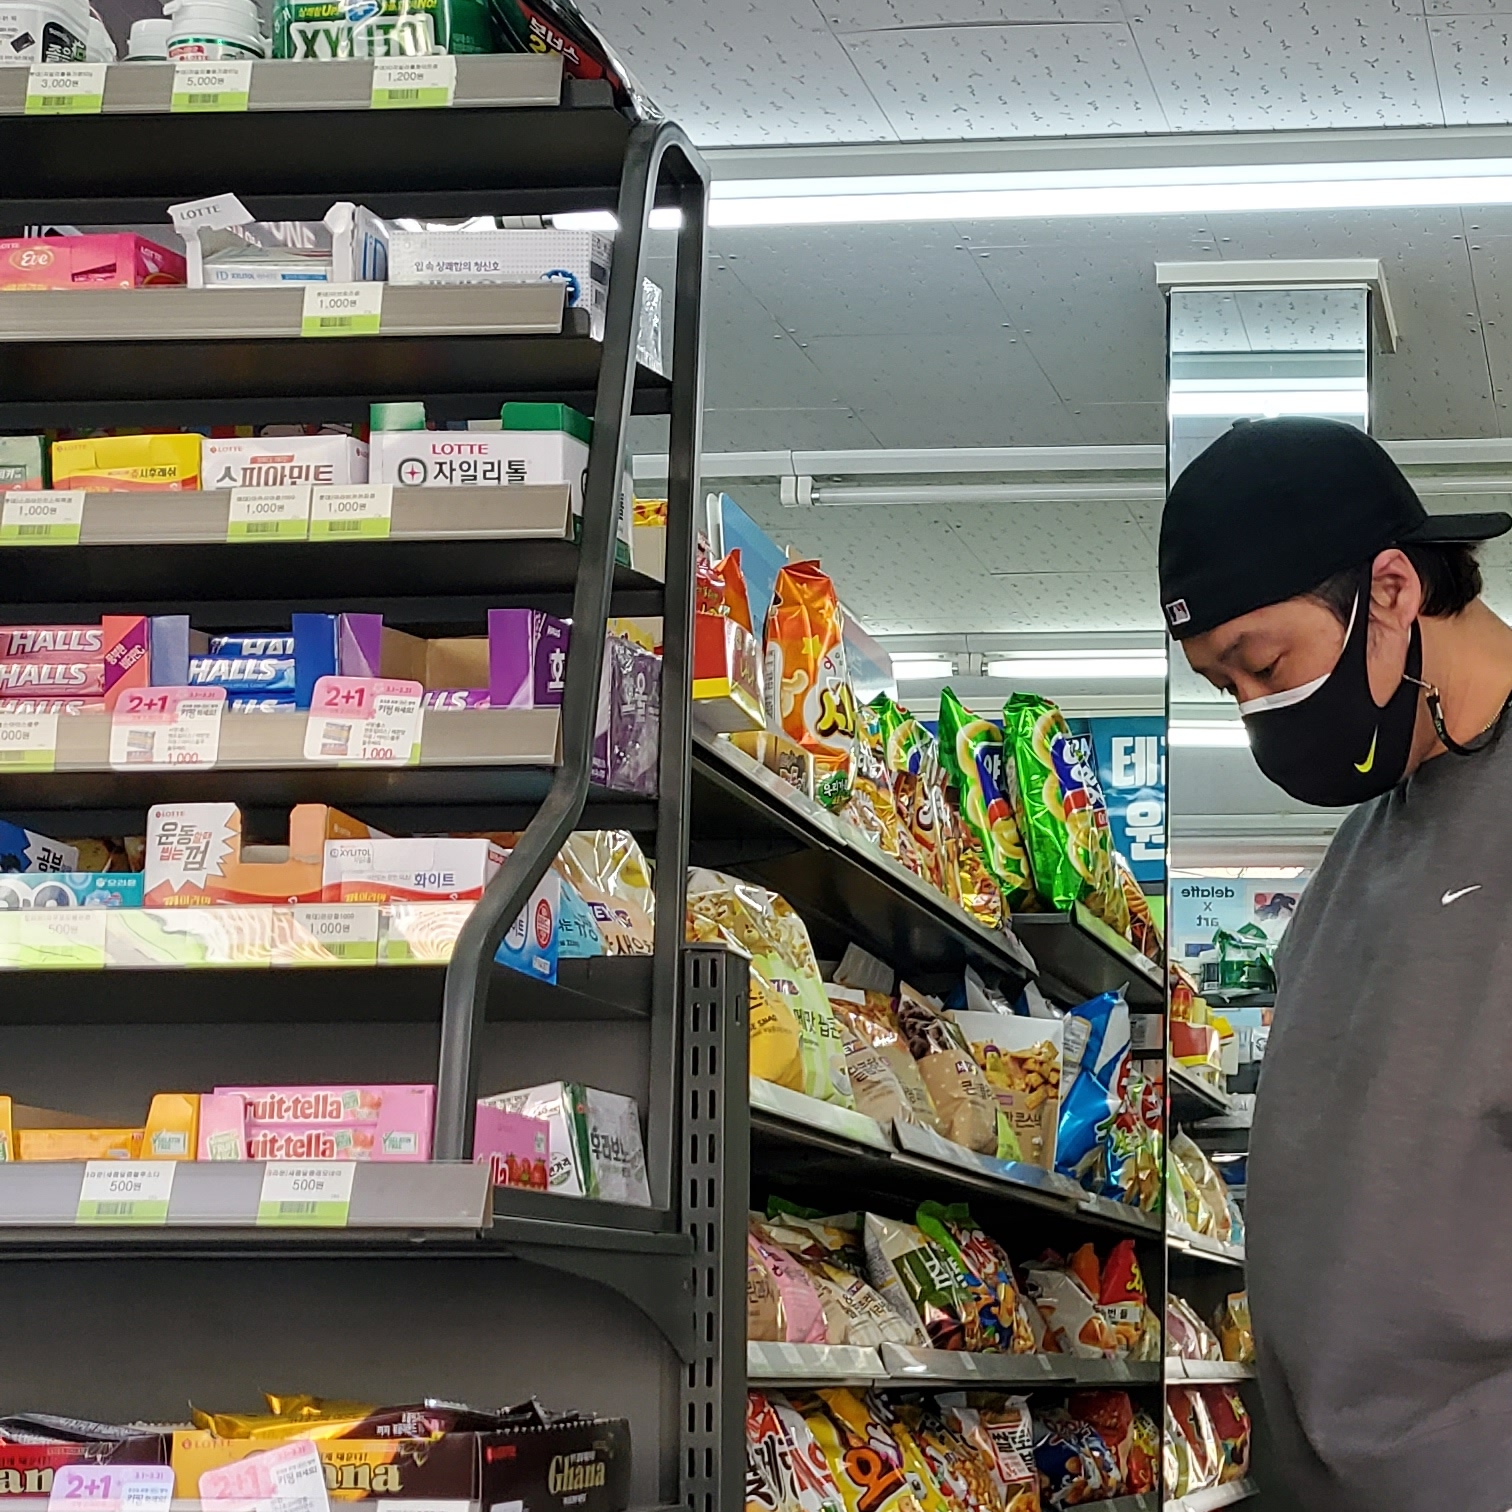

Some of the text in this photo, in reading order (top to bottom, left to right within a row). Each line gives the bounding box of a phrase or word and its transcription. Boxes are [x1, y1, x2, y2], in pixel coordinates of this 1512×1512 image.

[40, 79, 79, 88] 3,000원
[186, 77, 225, 87] 5,000원
[387, 72, 424, 82] 1,200원
[180, 204, 222, 219] LOTTE
[21, 252, 49, 267] Eve
[319, 299, 357, 310] 1,000원
[431, 443, 489, 456] LOTTE
[217, 464, 334, 487] 스피아민트
[432, 459, 528, 486] 자일리톨
[18, 505, 58, 516] 1,000원
[245, 503, 285, 514] 1,000원
[327, 502, 367, 514] 1,000원
[10, 629, 103, 656] HALLS
[0, 662, 88, 687] HALLS
[189, 658, 277, 683] HALLS
[324, 685, 366, 708] 2+1
[127, 694, 169, 714] 2+1
[166, 752, 199, 766] 1,000
[360, 746, 394, 760] 1,000
[339, 848, 372, 858] XYLITOL
[413, 871, 456, 888] 화이트
[309, 922, 350, 934] 1,000원
[109, 1180, 142, 1192] 500원
[292, 1177, 325, 1191] 500원
[208, 1463, 263, 1499] 2+1
[549, 1453, 607, 1495] Ghana
[65, 1475, 112, 1499] 2+1
